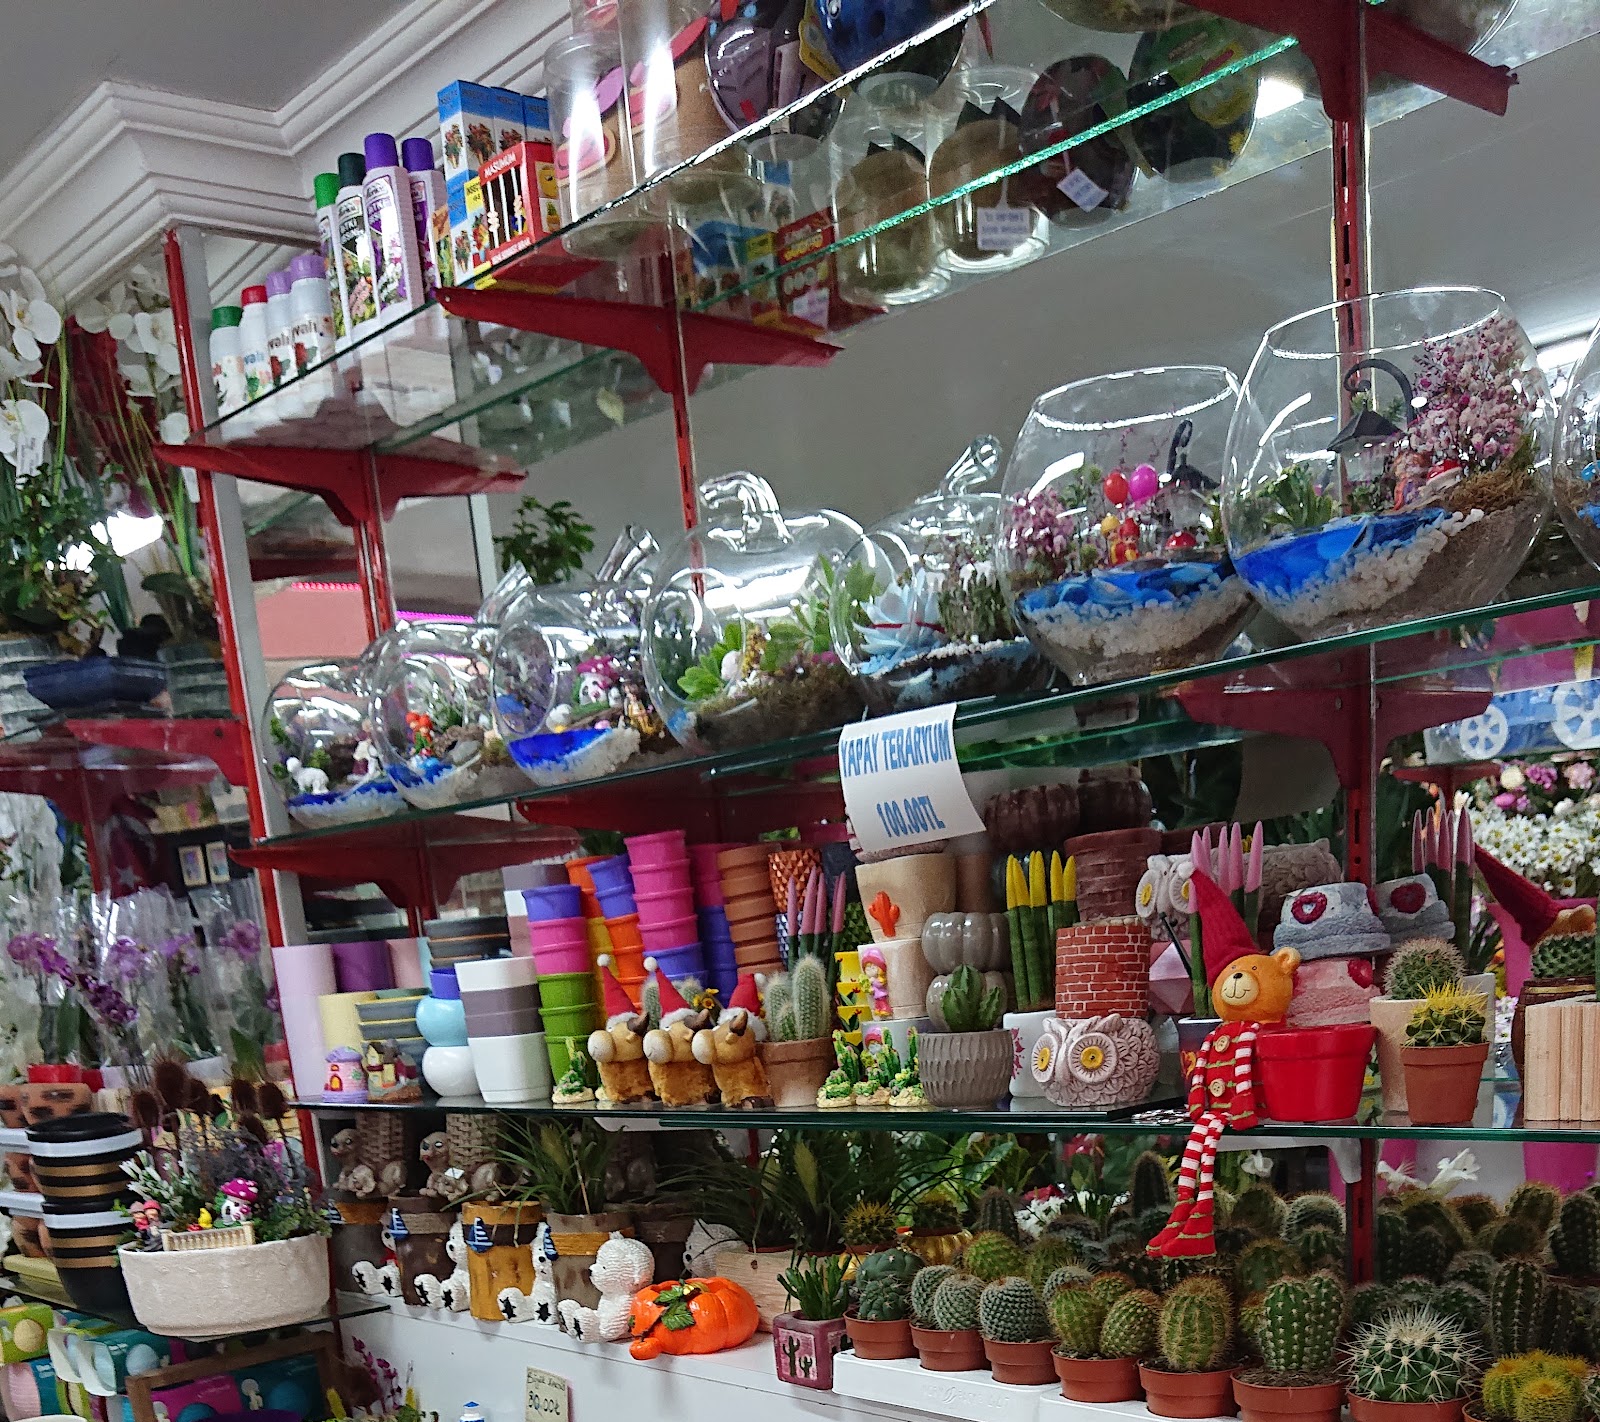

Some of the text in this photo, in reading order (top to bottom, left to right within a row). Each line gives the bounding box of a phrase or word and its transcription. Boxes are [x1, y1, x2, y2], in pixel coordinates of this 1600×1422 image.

[840, 719, 952, 777] YAPAY TERARYUM
[876, 795, 946, 838] 100.00TL
